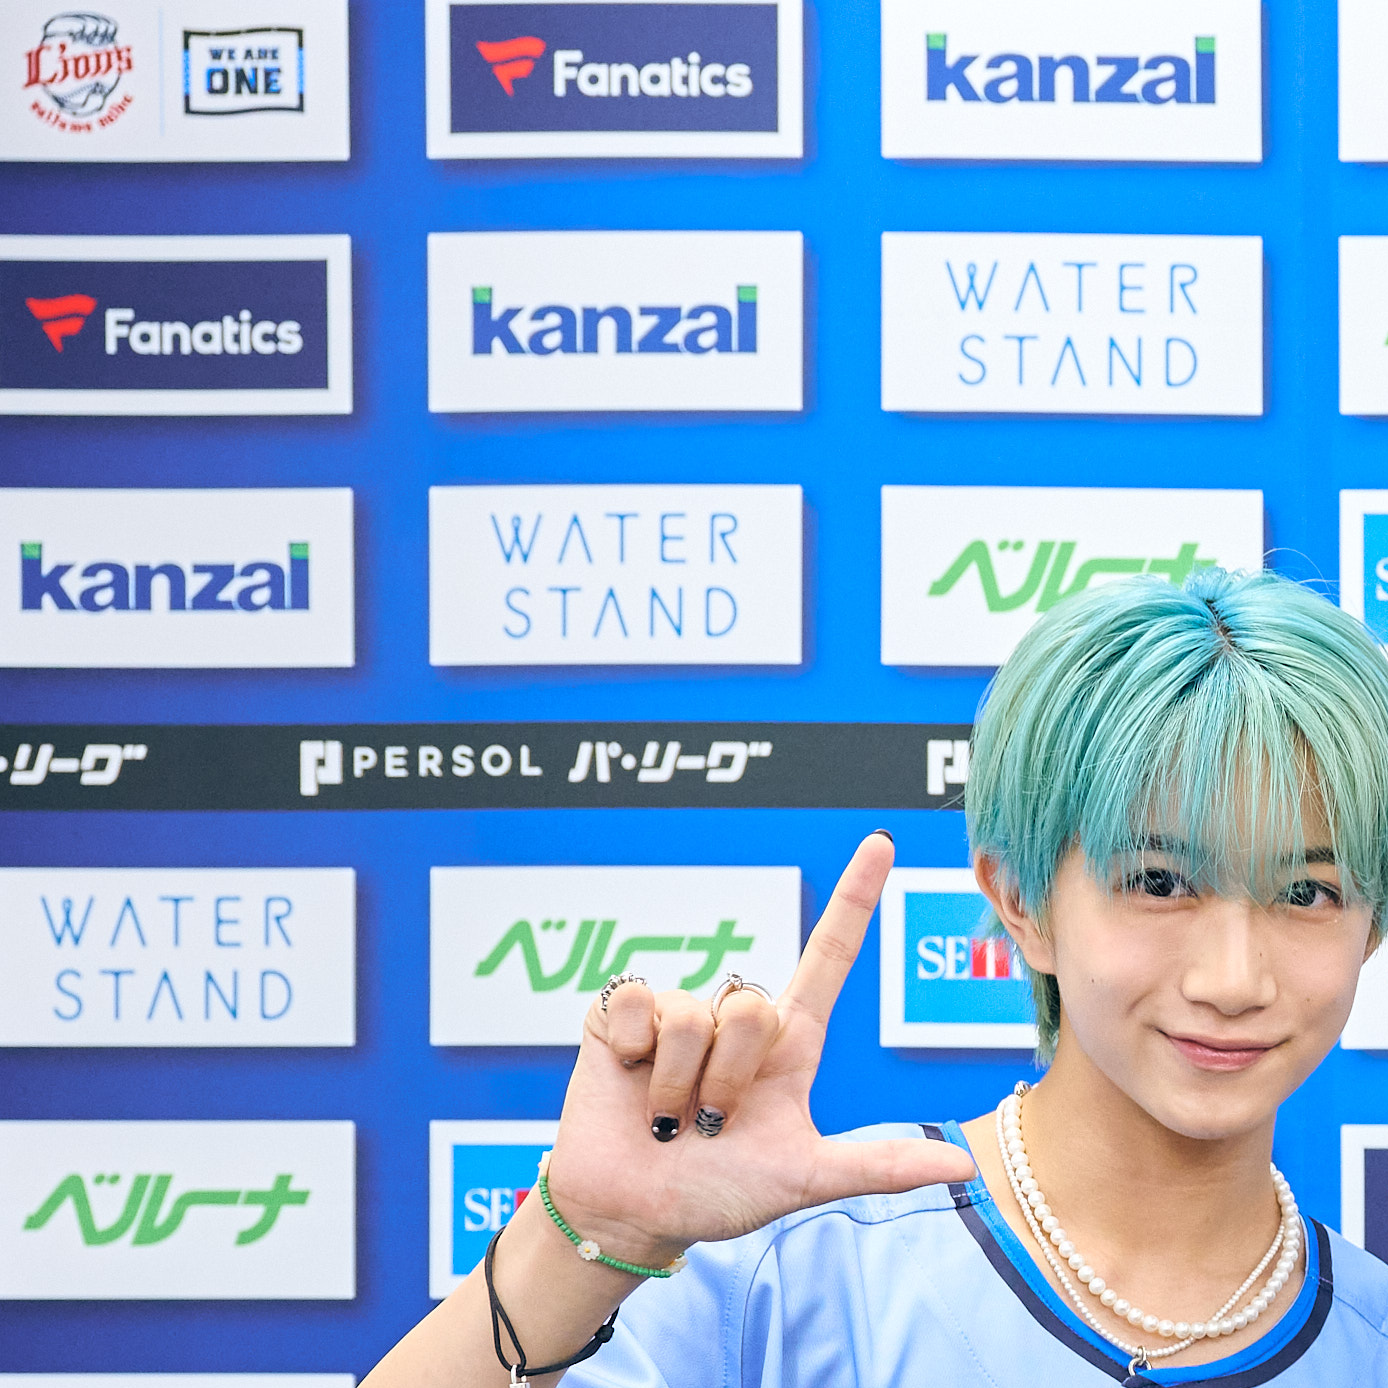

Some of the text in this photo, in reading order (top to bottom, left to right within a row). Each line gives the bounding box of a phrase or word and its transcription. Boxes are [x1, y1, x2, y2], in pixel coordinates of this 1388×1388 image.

[22, 42, 135, 90] Lions
[206, 67, 281, 95] ONE
[209, 48, 278, 61] WE ARE
[554, 50, 753, 97] Fanatics
[926, 34, 1216, 105] kanzai
[945, 261, 1198, 315] WATER
[105, 309, 303, 355] Fanatics
[471, 285, 757, 356] kanzai
[958, 334, 1198, 388] STAND
[490, 512, 738, 565] WATER
[20, 542, 310, 613] kanzai
[503, 586, 738, 640] STAND
[0, 744, 148, 785] ・リーグ
[354, 745, 542, 777] PERSOL
[40, 896, 293, 948] WATER
[475, 919, 754, 993] ベルーナ
[53, 968, 293, 1022] STAND
[23, 1173, 310, 1246] ベルーナ
